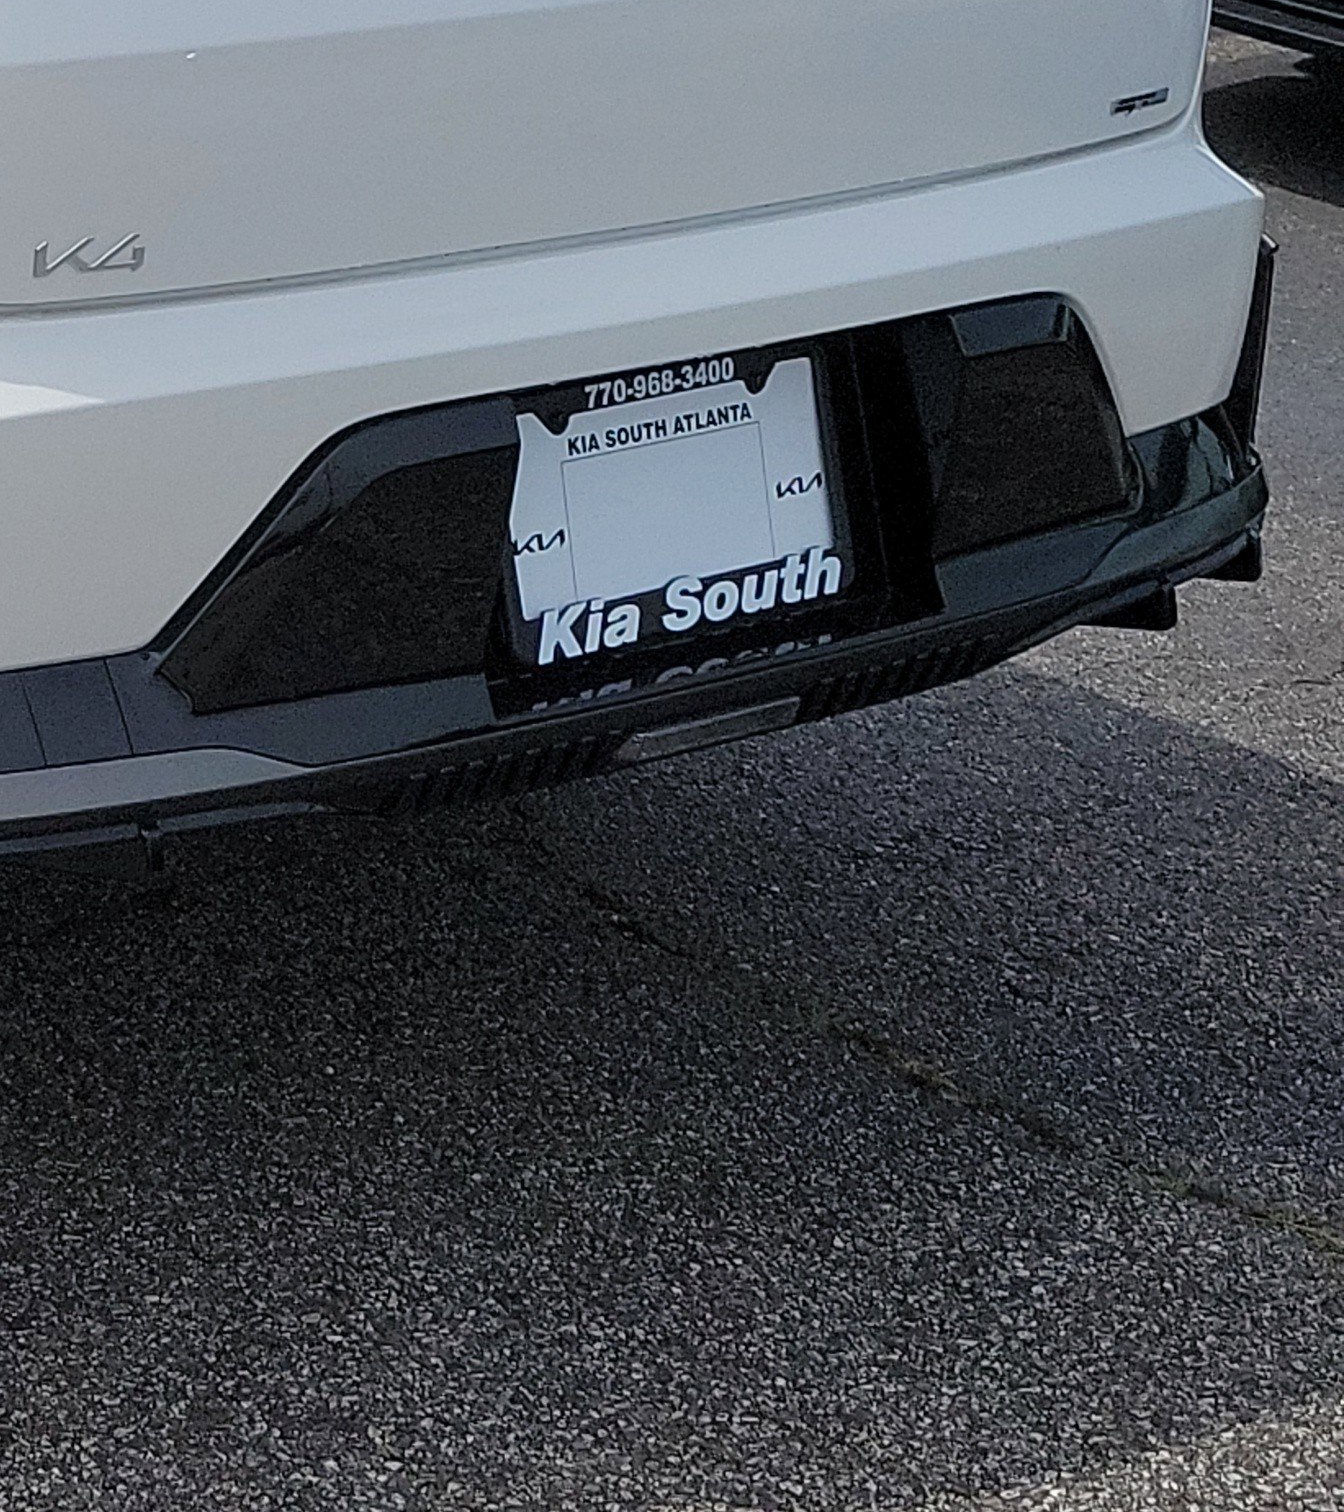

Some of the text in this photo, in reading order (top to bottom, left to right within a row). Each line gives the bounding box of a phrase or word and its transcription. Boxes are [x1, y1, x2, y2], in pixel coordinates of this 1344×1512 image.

[33, 232, 146, 278] K4
[584, 357, 735, 409] 770-968-3400
[567, 402, 753, 456] KIA SOUTH ATLANTA
[537, 545, 842, 666] Kia South
